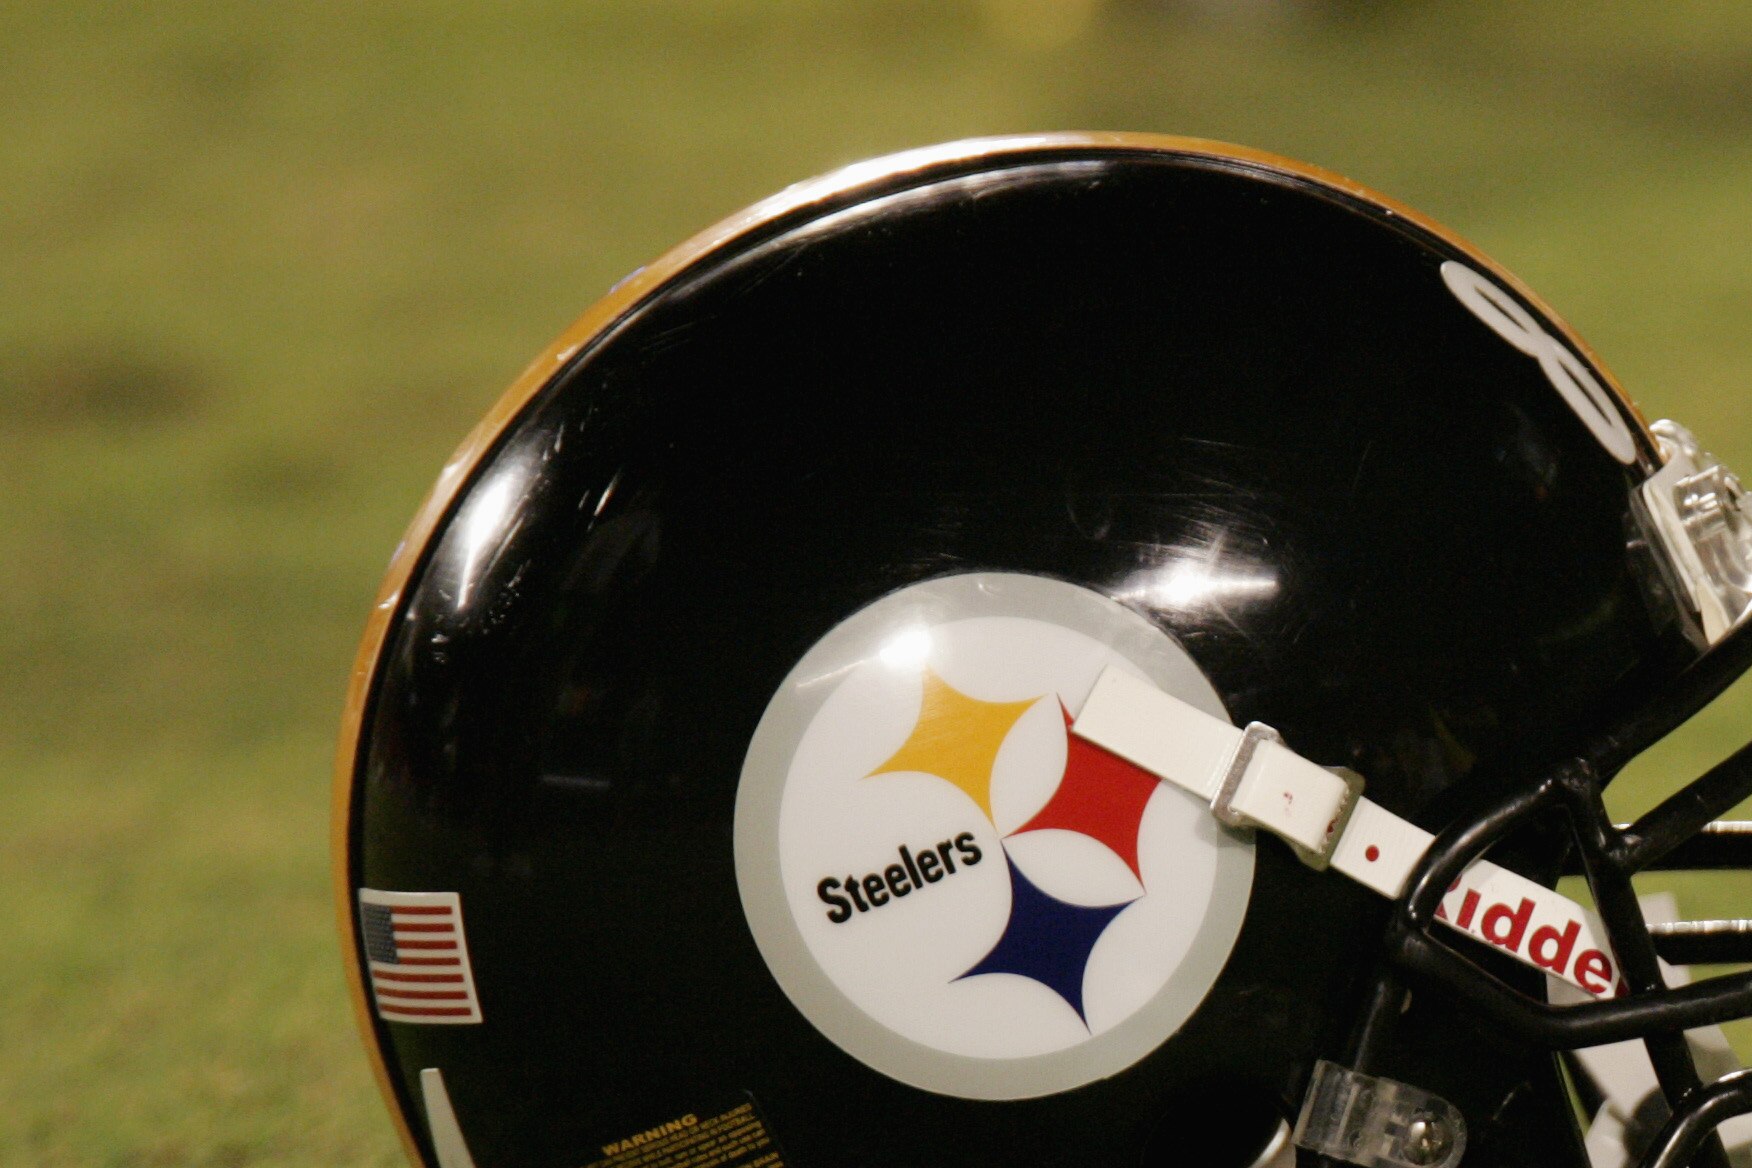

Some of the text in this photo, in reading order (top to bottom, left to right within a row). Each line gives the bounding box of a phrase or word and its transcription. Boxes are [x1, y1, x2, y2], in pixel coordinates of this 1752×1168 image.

[1440, 260, 1635, 465] 8
[818, 833, 982, 923] Steelers
[1433, 874, 1630, 997] idde
[601, 1112, 699, 1157] WARNING
